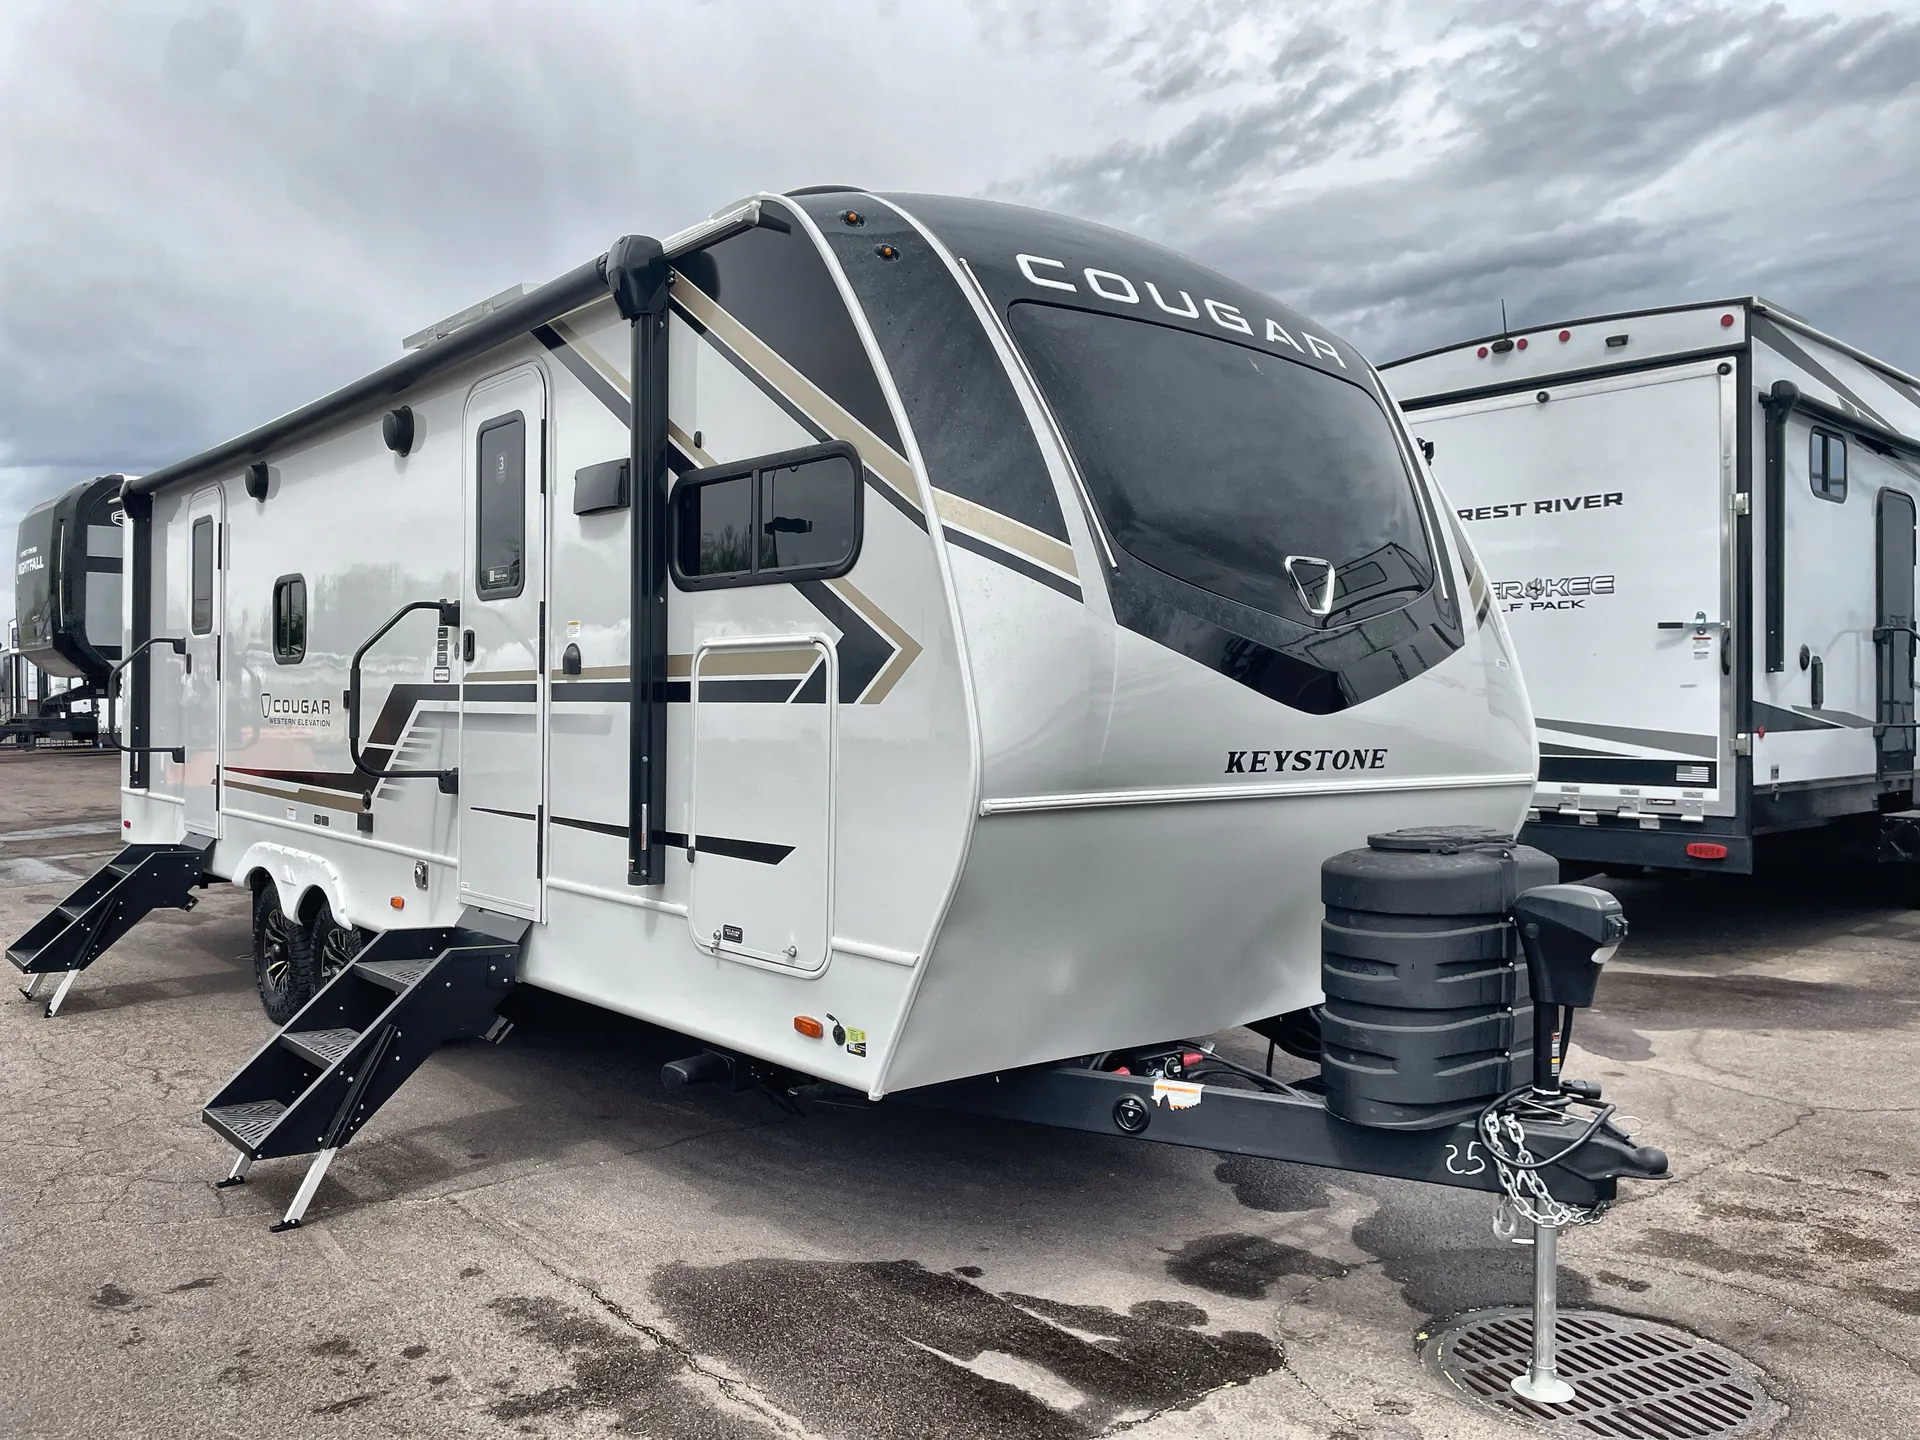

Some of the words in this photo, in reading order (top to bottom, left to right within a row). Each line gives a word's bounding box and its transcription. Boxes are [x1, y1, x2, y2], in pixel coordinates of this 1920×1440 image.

[1015, 252, 1348, 370] COUGAR
[498, 455, 505, 471] 3
[1457, 502, 1528, 521] REST
[1533, 491, 1624, 515] RIVER
[1530, 599, 1587, 612] PACK
[273, 699, 331, 715] COUGAR
[269, 717, 296, 726] WESTERN
[297, 718, 331, 727] ELEVATION
[1224, 748, 1388, 774] KEYSTONE
[1445, 1140, 1486, 1175] 25
